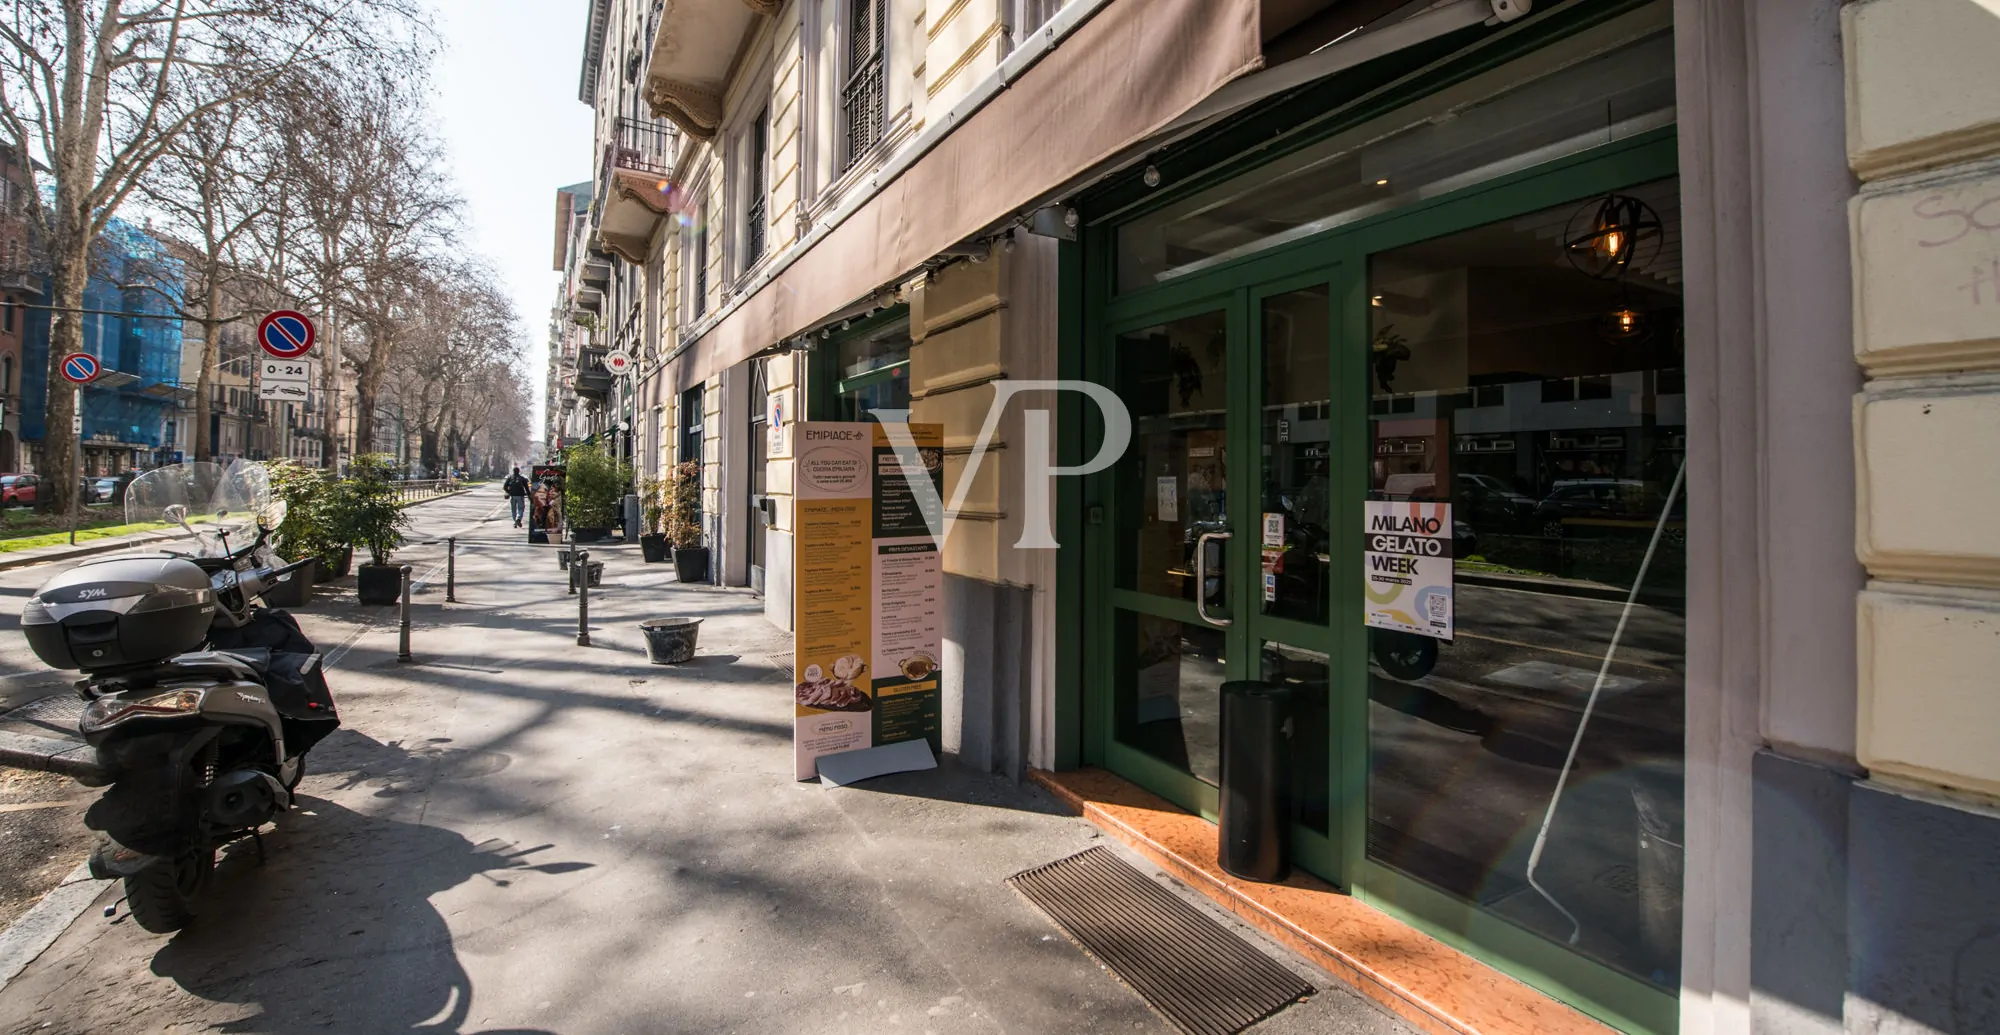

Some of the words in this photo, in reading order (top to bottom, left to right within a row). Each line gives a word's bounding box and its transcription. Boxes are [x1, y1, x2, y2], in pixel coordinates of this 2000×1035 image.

[285, 366, 303, 375] 24
[806, 430, 853, 441] EMIPIACE
[1372, 515, 1441, 534] MILANO
[1372, 535, 1442, 556] GELATO
[1372, 555, 1419, 575] WEEK
[78, 588, 107, 600] SYM
